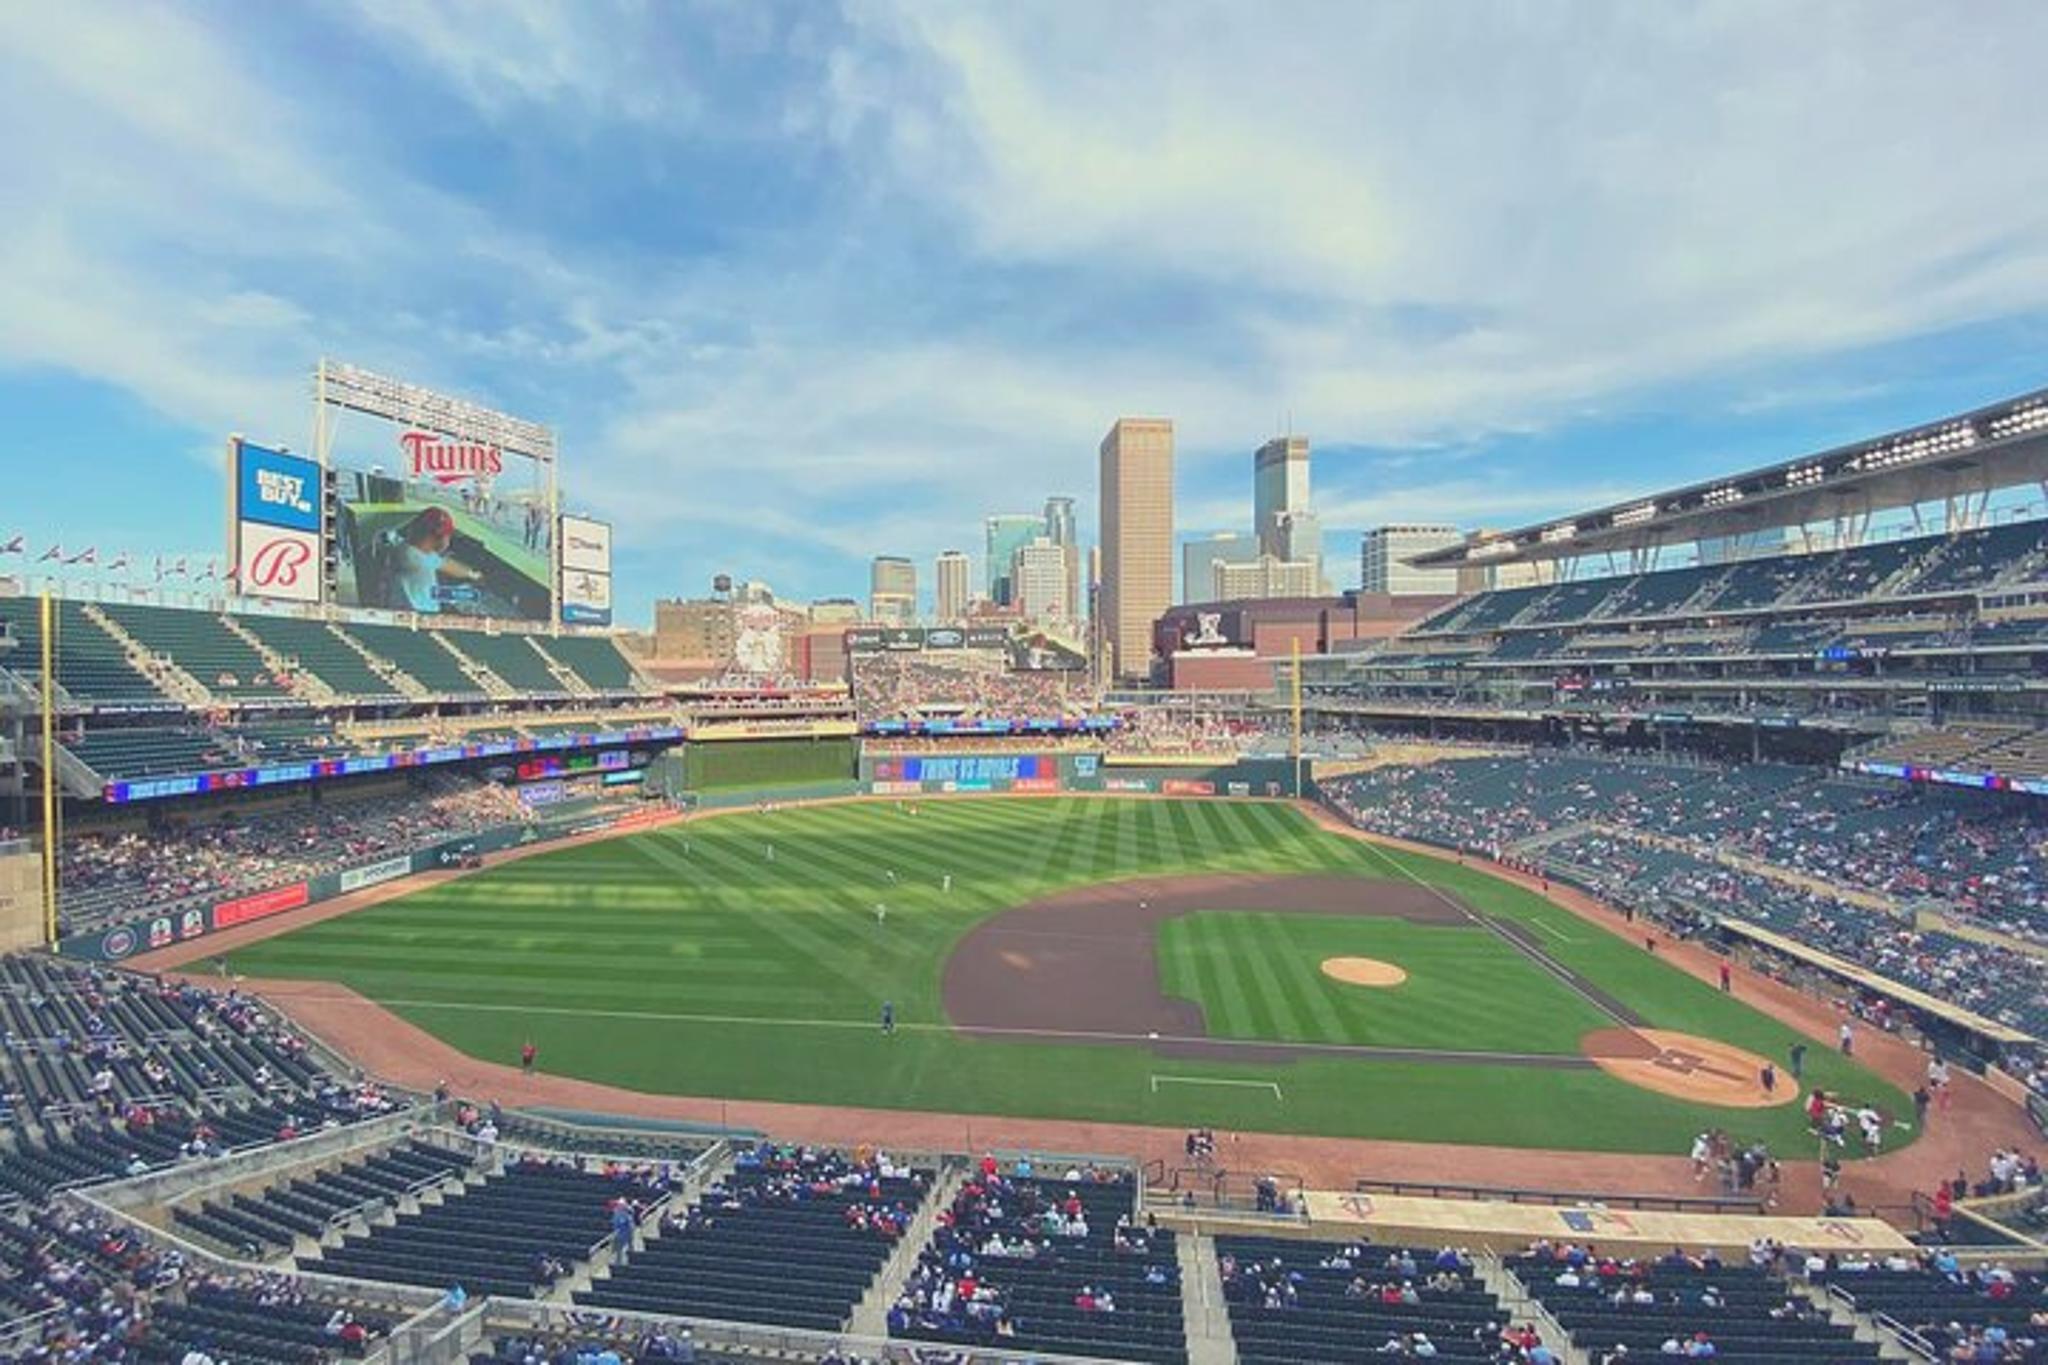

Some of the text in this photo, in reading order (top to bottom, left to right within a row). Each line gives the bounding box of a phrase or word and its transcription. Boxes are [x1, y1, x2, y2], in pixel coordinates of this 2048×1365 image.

[402, 431, 502, 477] Twins
[256, 468, 304, 489] BEST
[251, 539, 311, 587] B
[921, 758, 1019, 780] TWINS VS ROYALS
